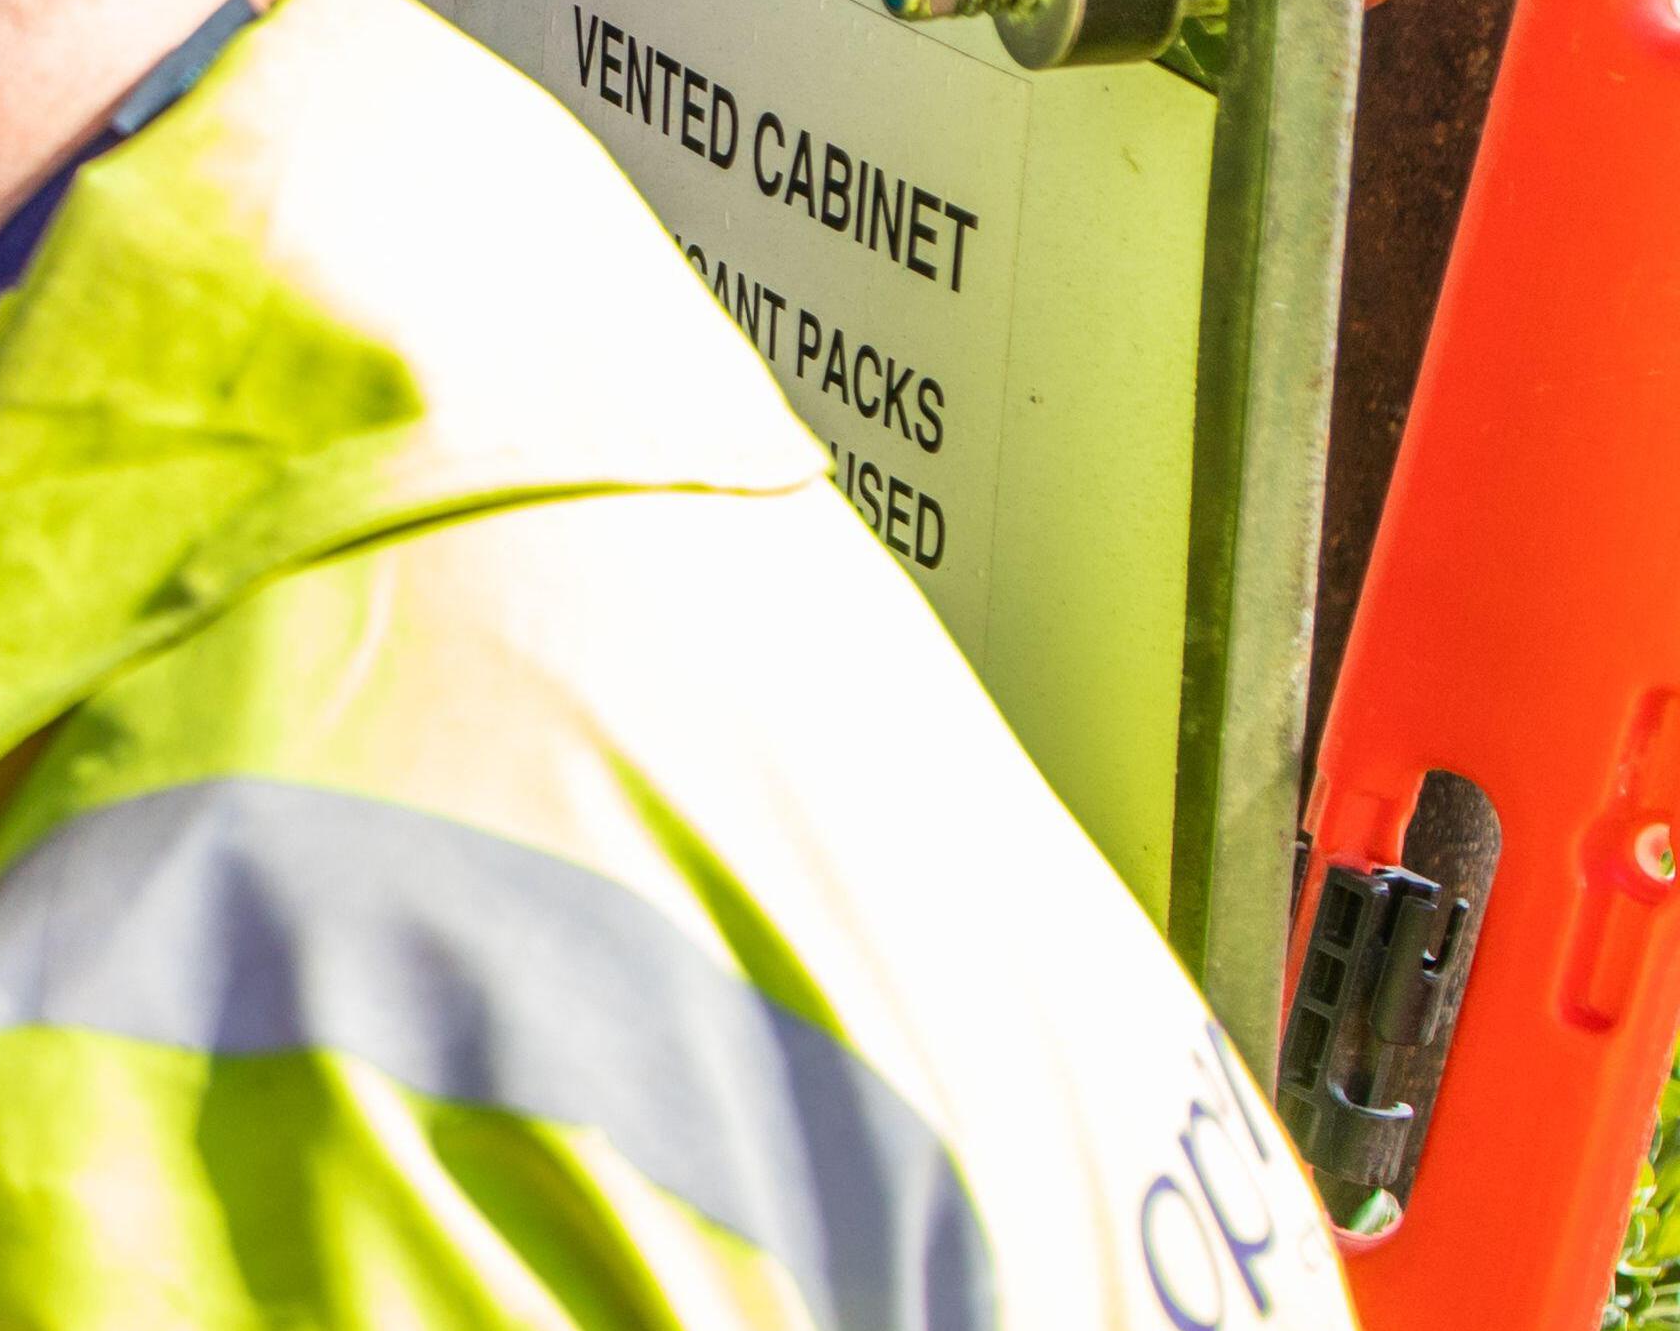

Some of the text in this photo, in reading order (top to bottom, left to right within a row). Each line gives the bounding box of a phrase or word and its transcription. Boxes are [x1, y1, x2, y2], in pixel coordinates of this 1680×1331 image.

[573, 4, 979, 293] VENTED CABINET
[796, 307, 945, 455] PACKS
